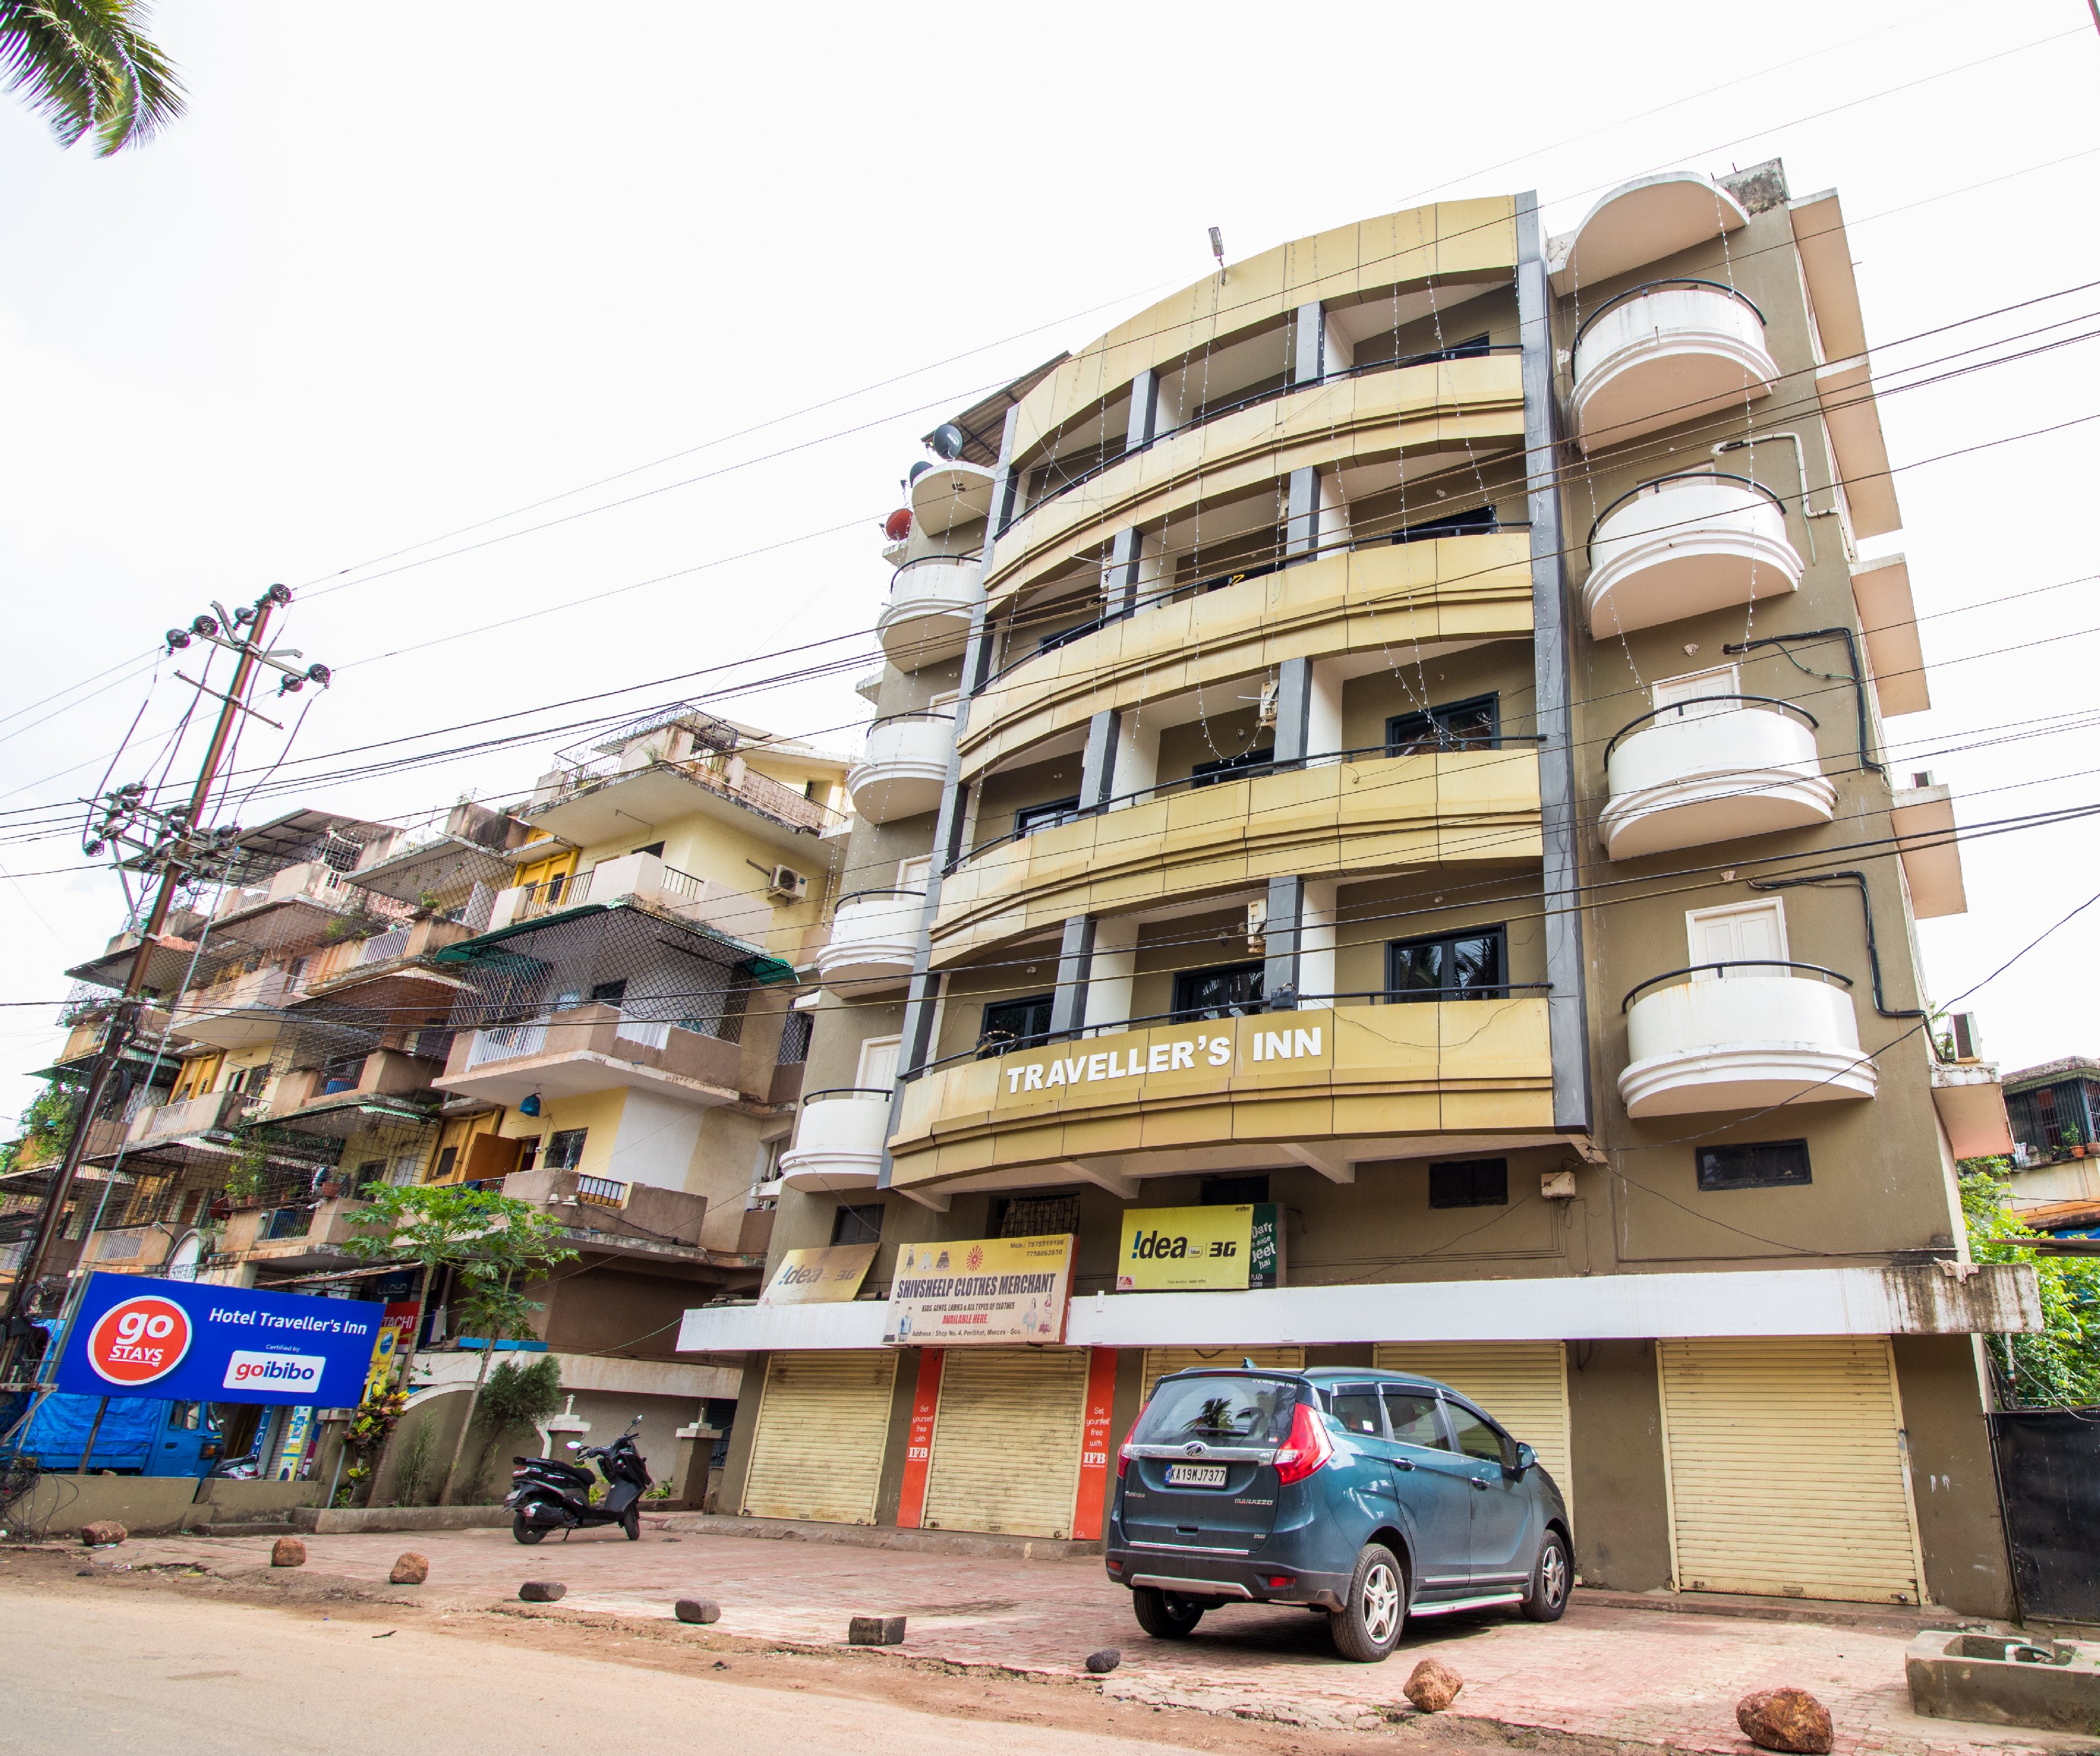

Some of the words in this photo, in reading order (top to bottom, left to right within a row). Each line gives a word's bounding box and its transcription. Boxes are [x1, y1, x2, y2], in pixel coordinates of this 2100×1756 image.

[1007, 1035, 1230, 1093] TRAVELLER'S
[1253, 1027, 1321, 1061] INN
[1209, 1241, 1236, 1257] 3G
[1259, 1258, 1271, 1270] hai
[834, 1268, 858, 1281] 3G
[897, 1276, 953, 1298] SHIVSHEELP
[954, 1275, 997, 1296] CLOTHES
[998, 1273, 1056, 1295] MERCHANT
[209, 1308, 257, 1325] Hotel
[260, 1313, 341, 1333] Traveller's
[343, 1321, 367, 1335] Inn
[382, 1316, 414, 1329] TACHI
[942, 1315, 971, 1324] AVAILABLE
[116, 1312, 174, 1345] go
[110, 1345, 164, 1361] STAYS
[235, 1361, 315, 1381] goibibo
[908, 1447, 928, 1458] IFB
[1084, 1452, 1106, 1464] IFB
[1170, 1468, 1225, 1482] KA19MJ7377
